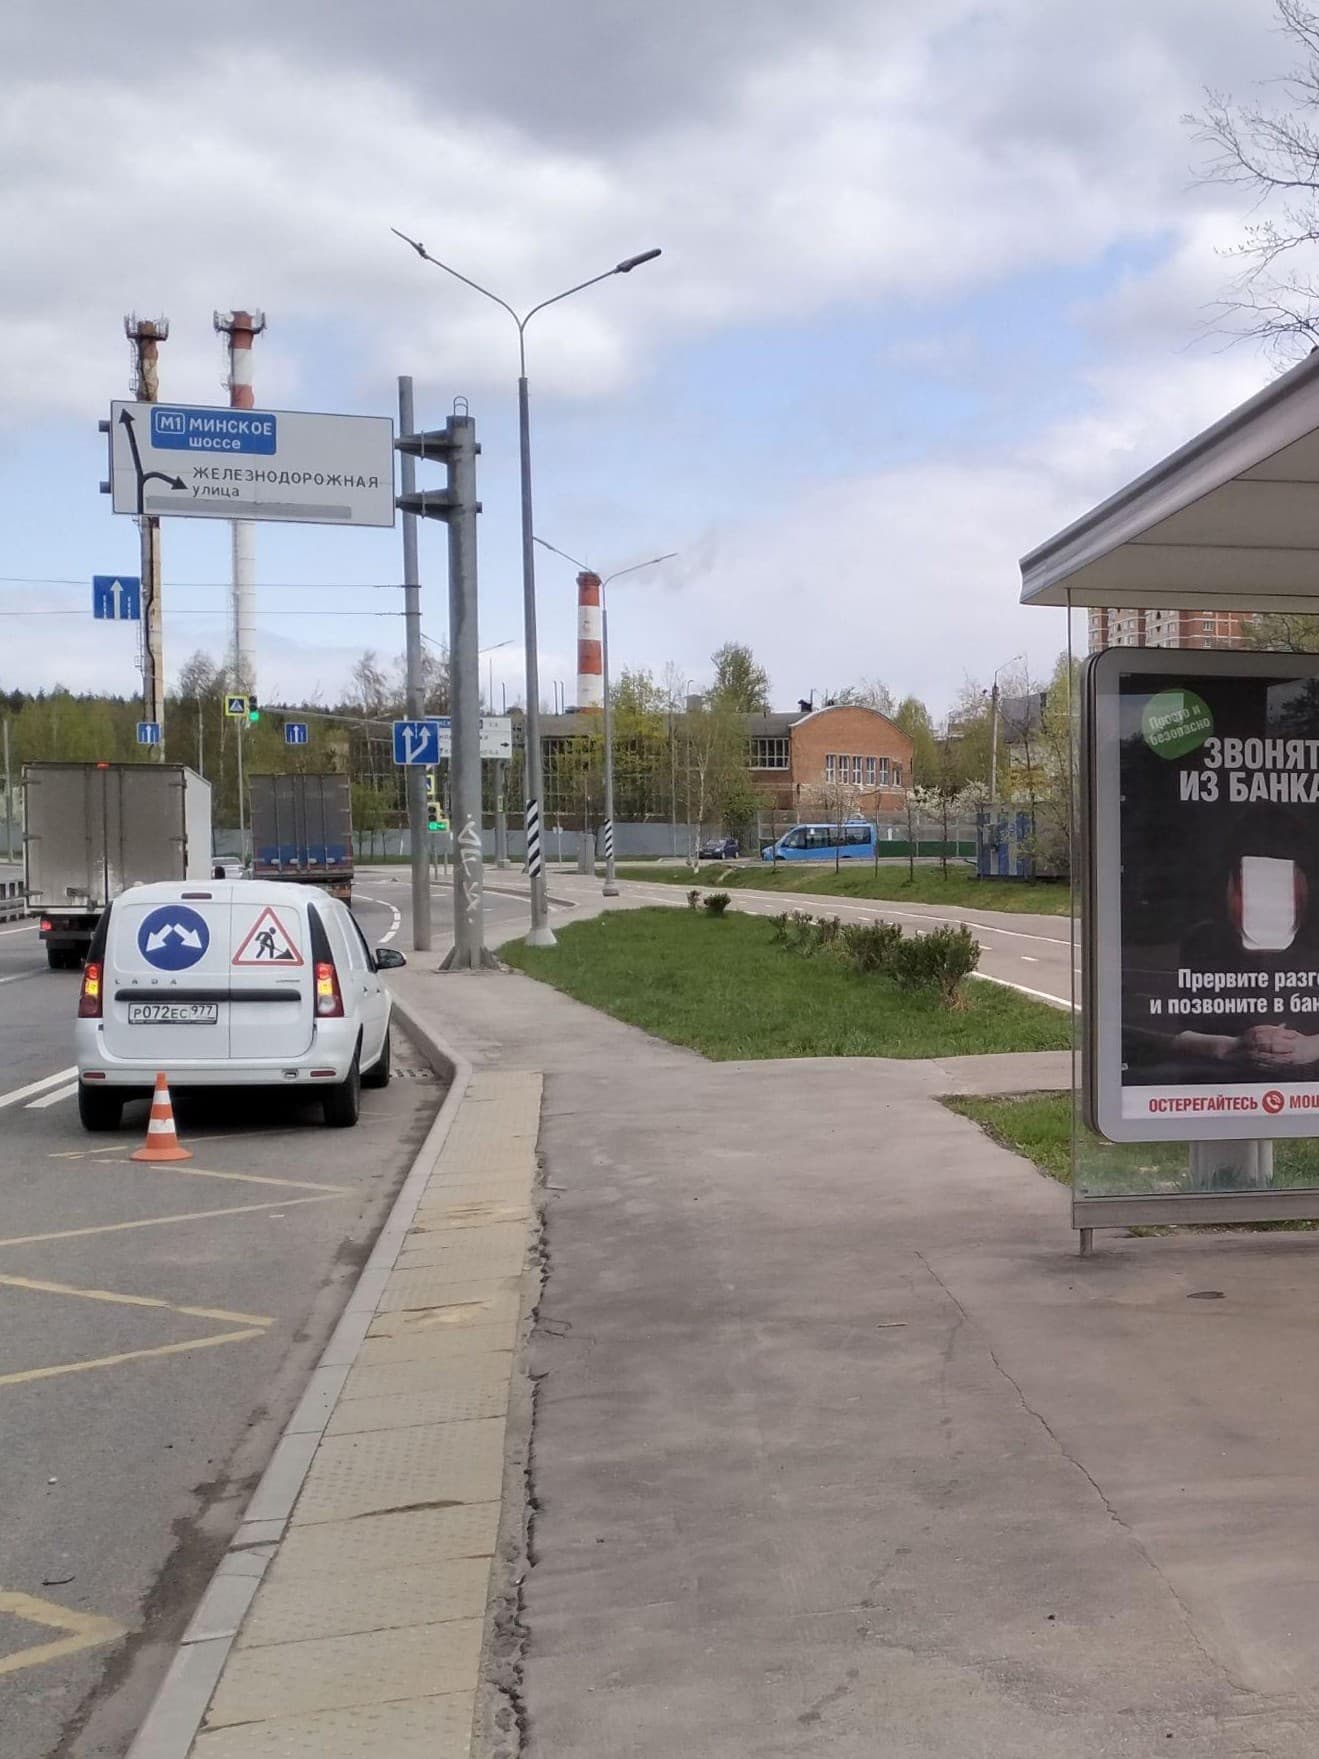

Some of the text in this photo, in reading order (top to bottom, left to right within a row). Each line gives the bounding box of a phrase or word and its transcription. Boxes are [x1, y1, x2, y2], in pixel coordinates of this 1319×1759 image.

[189, 418, 272, 436] МИНСКОЕ
[189, 436, 241, 449] шоссе
[193, 467, 379, 488] ЖЕЛЕЗНОДОРОЖНАЯ
[192, 484, 240, 497] улица
[1150, 718, 1210, 745] безопасно
[1179, 770, 1219, 802] ИЗ
[1178, 968, 1269, 992] Прервите
[1150, 998, 1162, 1014] и
[1168, 997, 1268, 1014] позвоните
[1274, 997, 1284, 1012] в
[1149, 1094, 1258, 1112] ОСТЕРЕГАЙТЕСЬ
